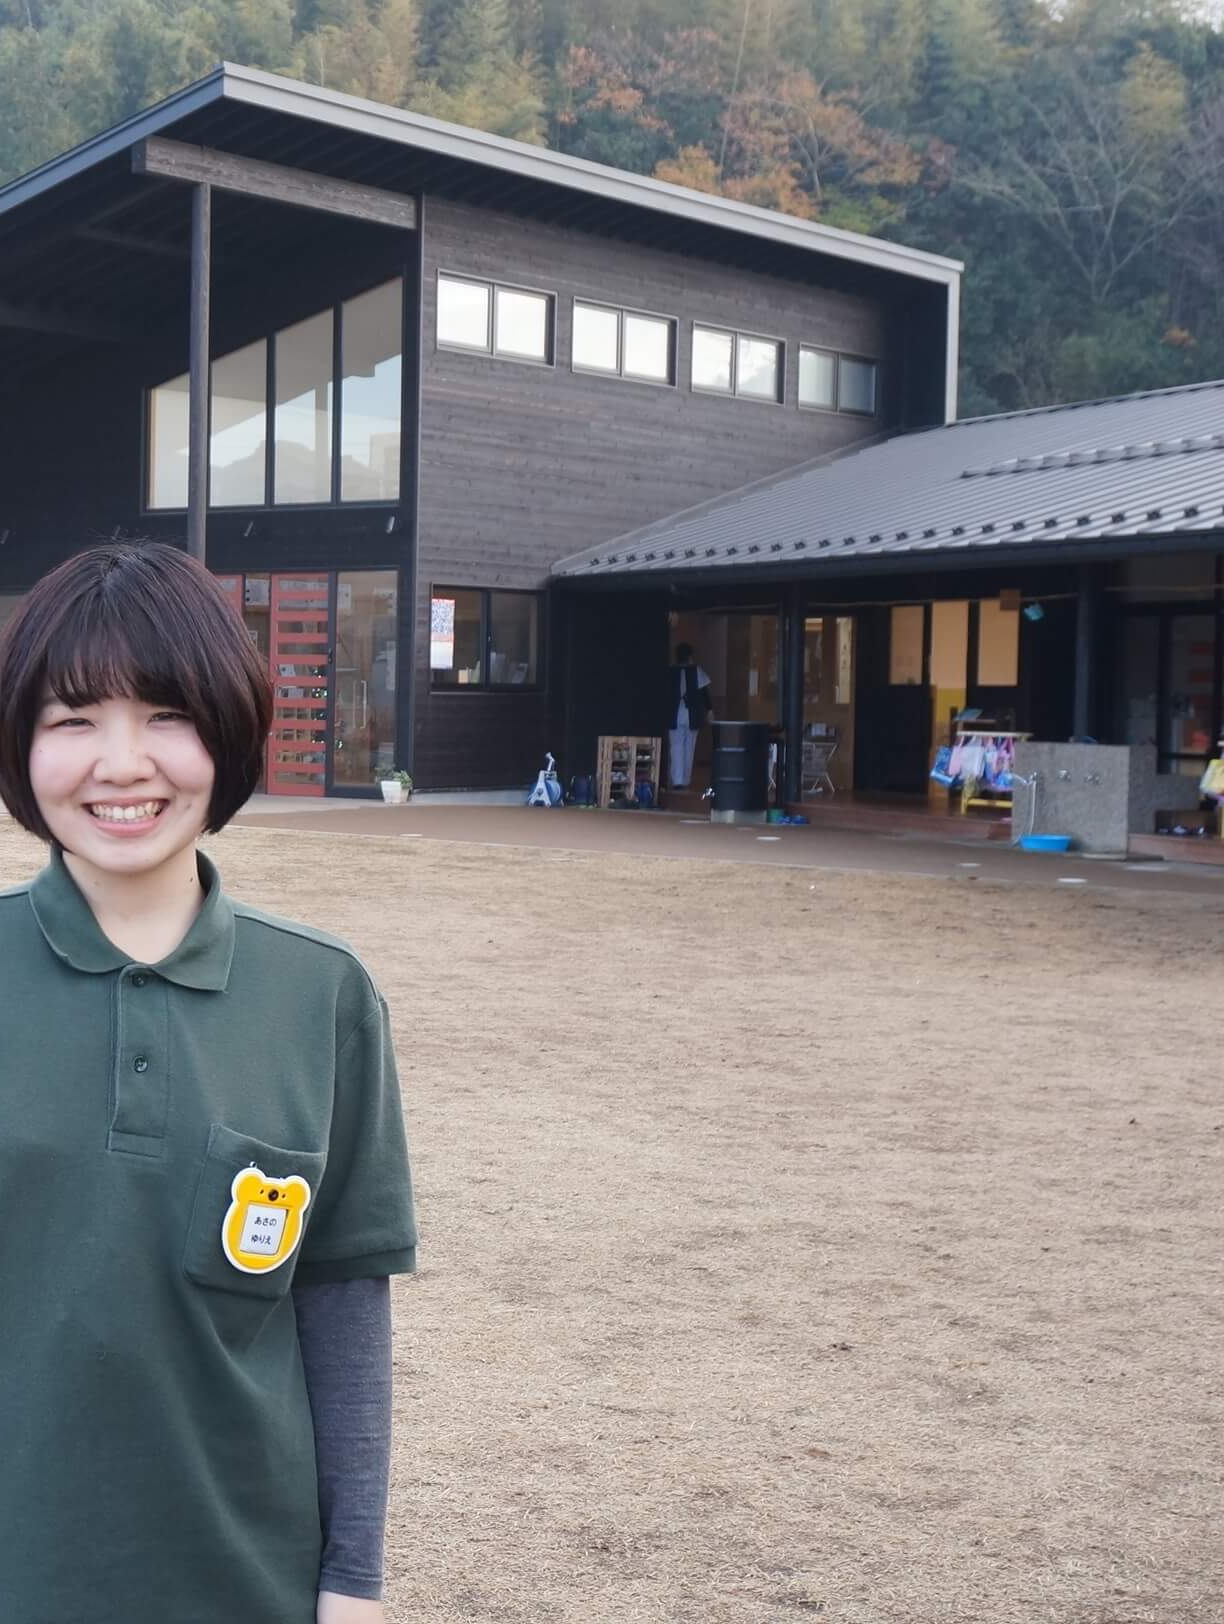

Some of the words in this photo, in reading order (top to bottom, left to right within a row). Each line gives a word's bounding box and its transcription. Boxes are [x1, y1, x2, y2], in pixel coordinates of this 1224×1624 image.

[254, 1216, 277, 1226] あさの
[251, 1234, 271, 1245] ゆりえ
